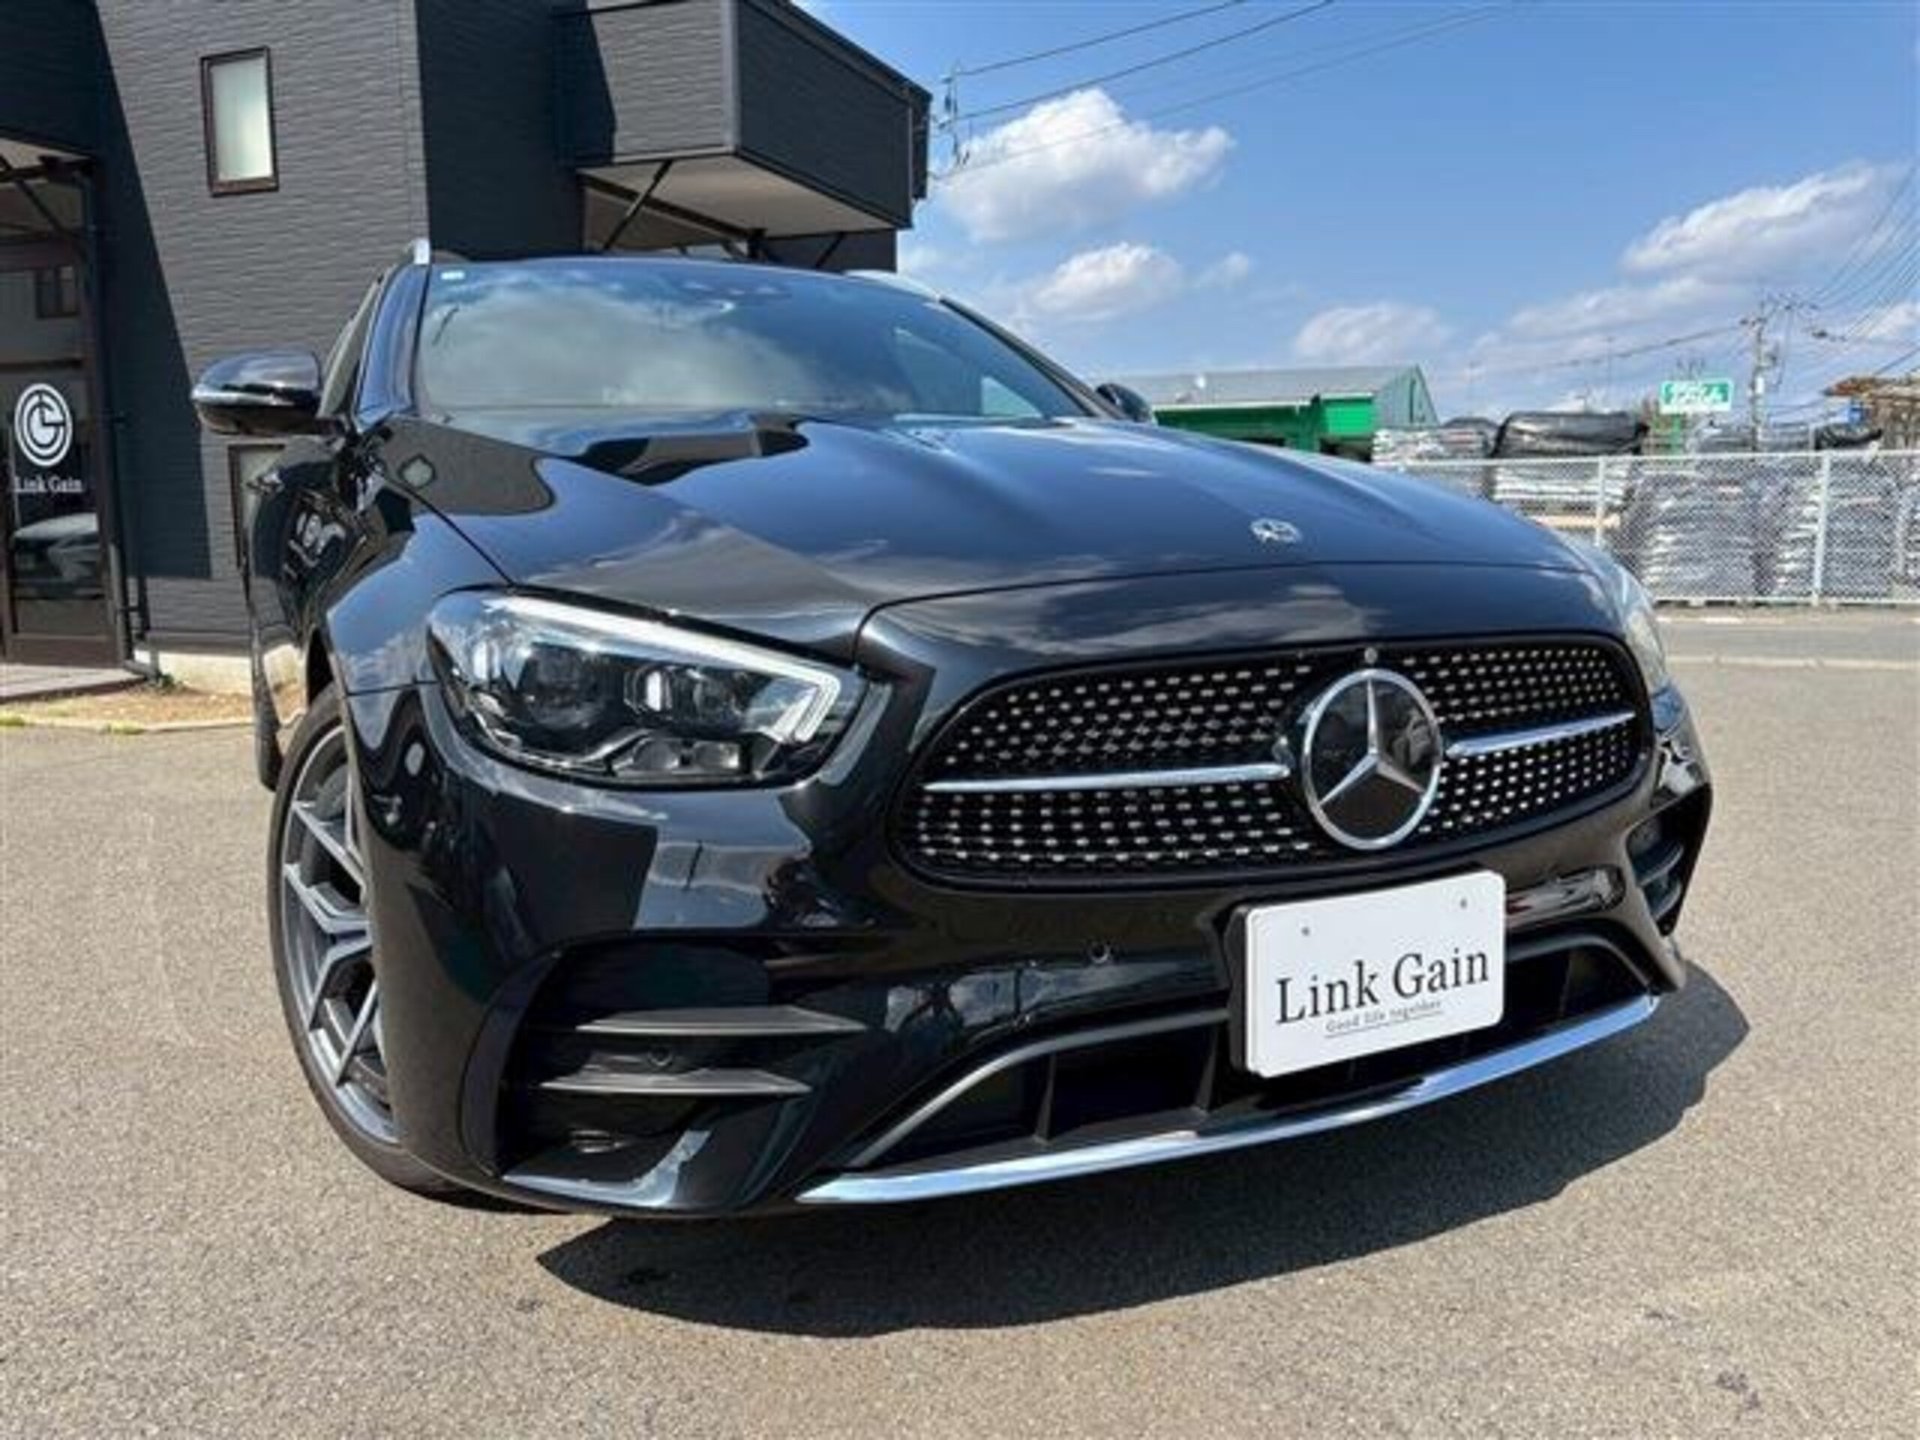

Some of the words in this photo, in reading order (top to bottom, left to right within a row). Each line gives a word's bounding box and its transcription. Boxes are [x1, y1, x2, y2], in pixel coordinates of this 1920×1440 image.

[14, 474, 46, 493] Link
[48, 474, 83, 493] Gain
[1276, 958, 1381, 1025] Link
[1392, 947, 1489, 999] Gain
[1325, 1014, 1360, 1033] Good
[1364, 1008, 1386, 1024] life
